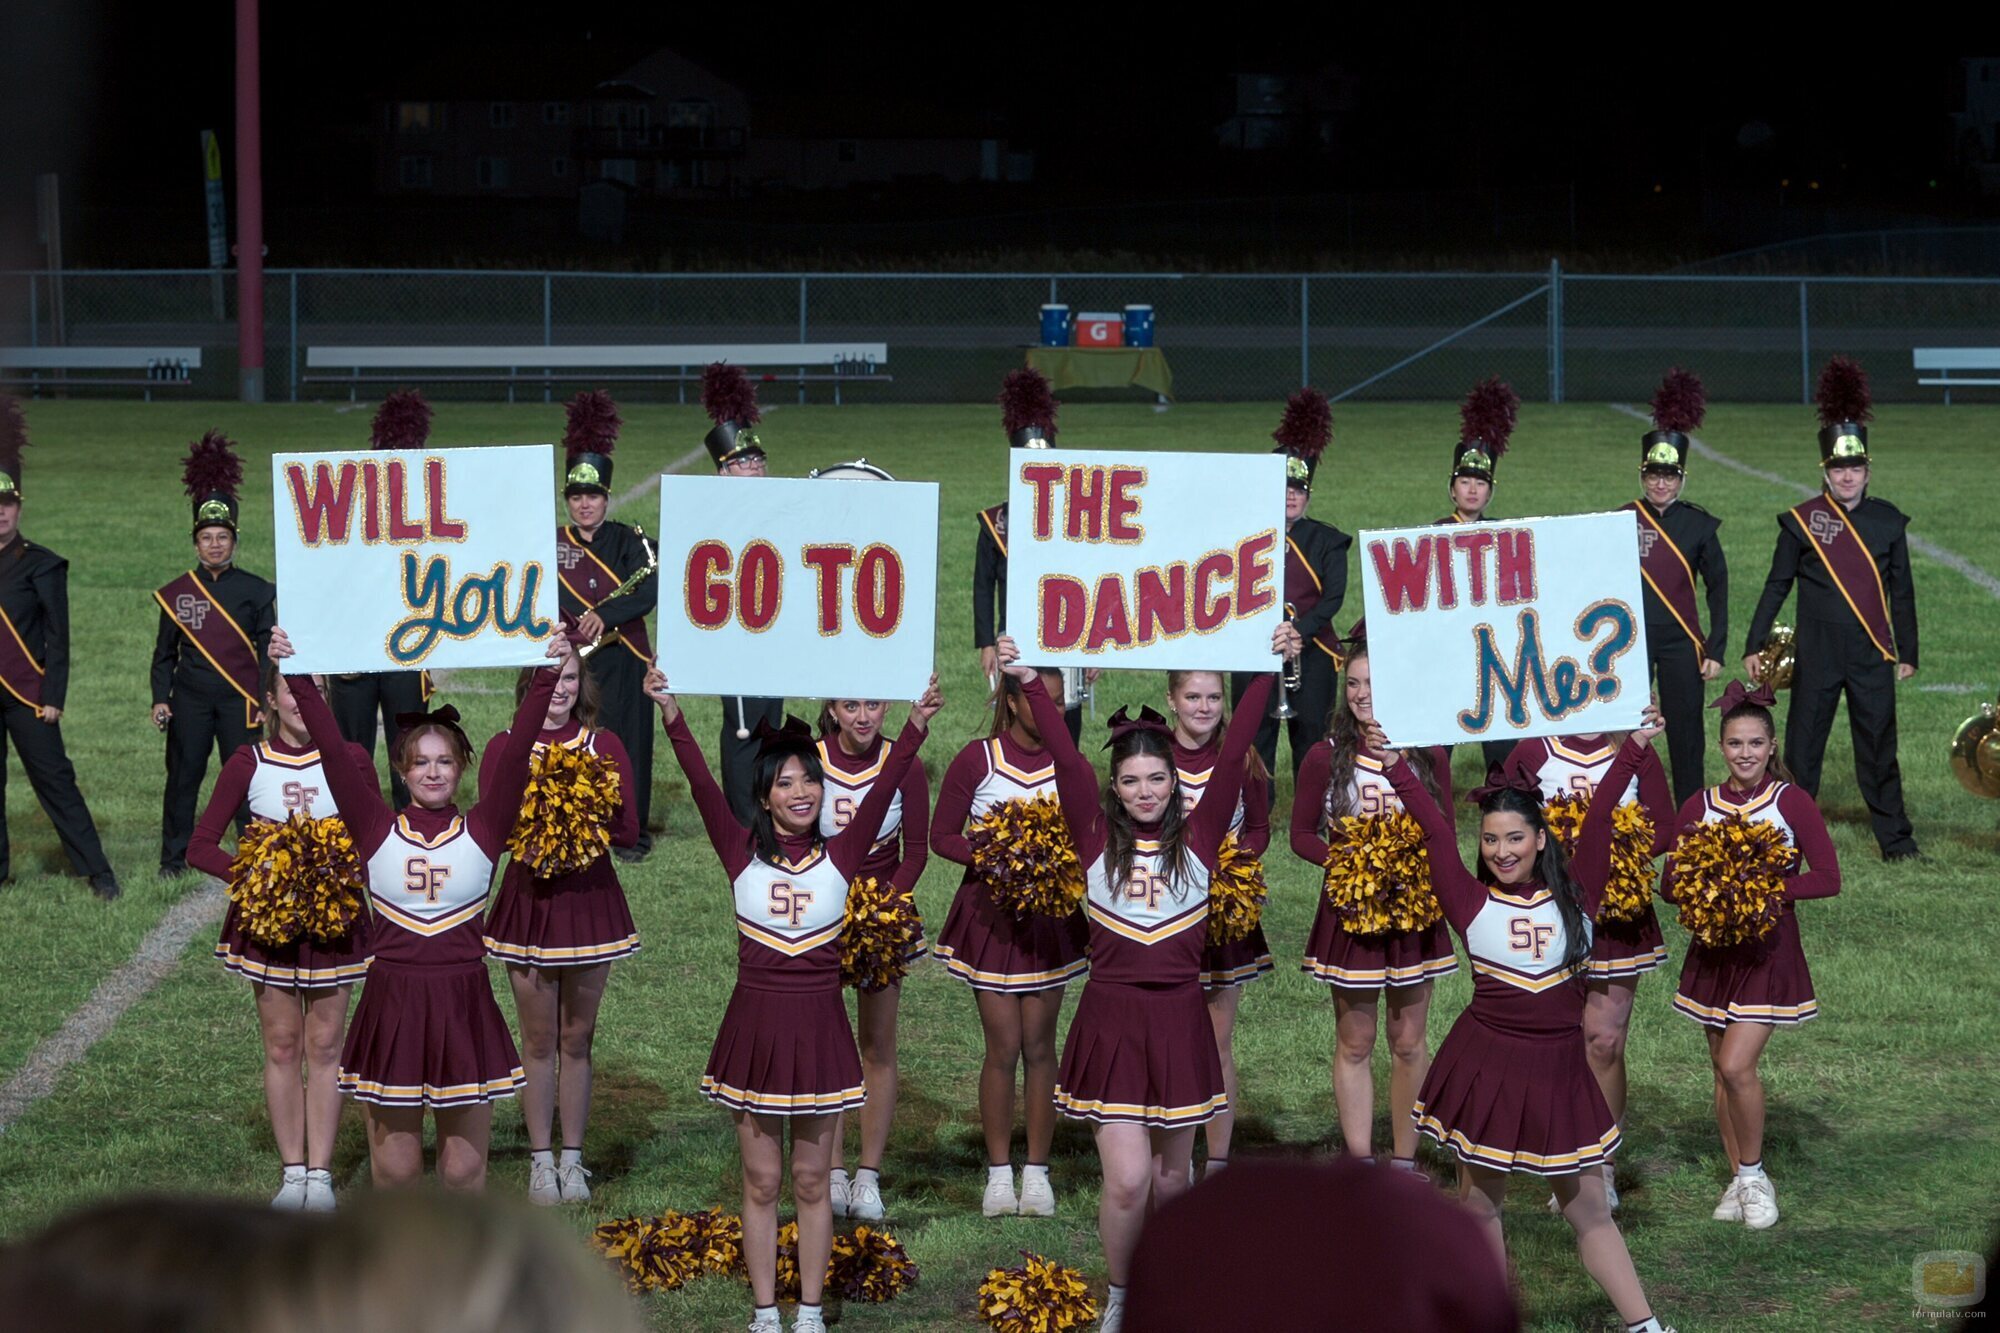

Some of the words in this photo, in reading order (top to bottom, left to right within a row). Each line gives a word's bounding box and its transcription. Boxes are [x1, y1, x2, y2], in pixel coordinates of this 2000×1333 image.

[1090, 323, 1108, 341] G
[283, 456, 468, 548] WILL
[1020, 462, 1148, 546] THE
[1809, 509, 1844, 545] SF
[684, 538, 784, 634] GO
[801, 541, 905, 638] TO
[1038, 528, 1277, 654] DANCE
[1367, 527, 1538, 615] WITH
[176, 594, 211, 629] SF
[1457, 598, 1637, 733] Me?
[282, 781, 319, 815] SF
[832, 795, 860, 829] S
[405, 855, 451, 904] SF
[768, 880, 813, 928] SF
[1507, 915, 1556, 961] SF
